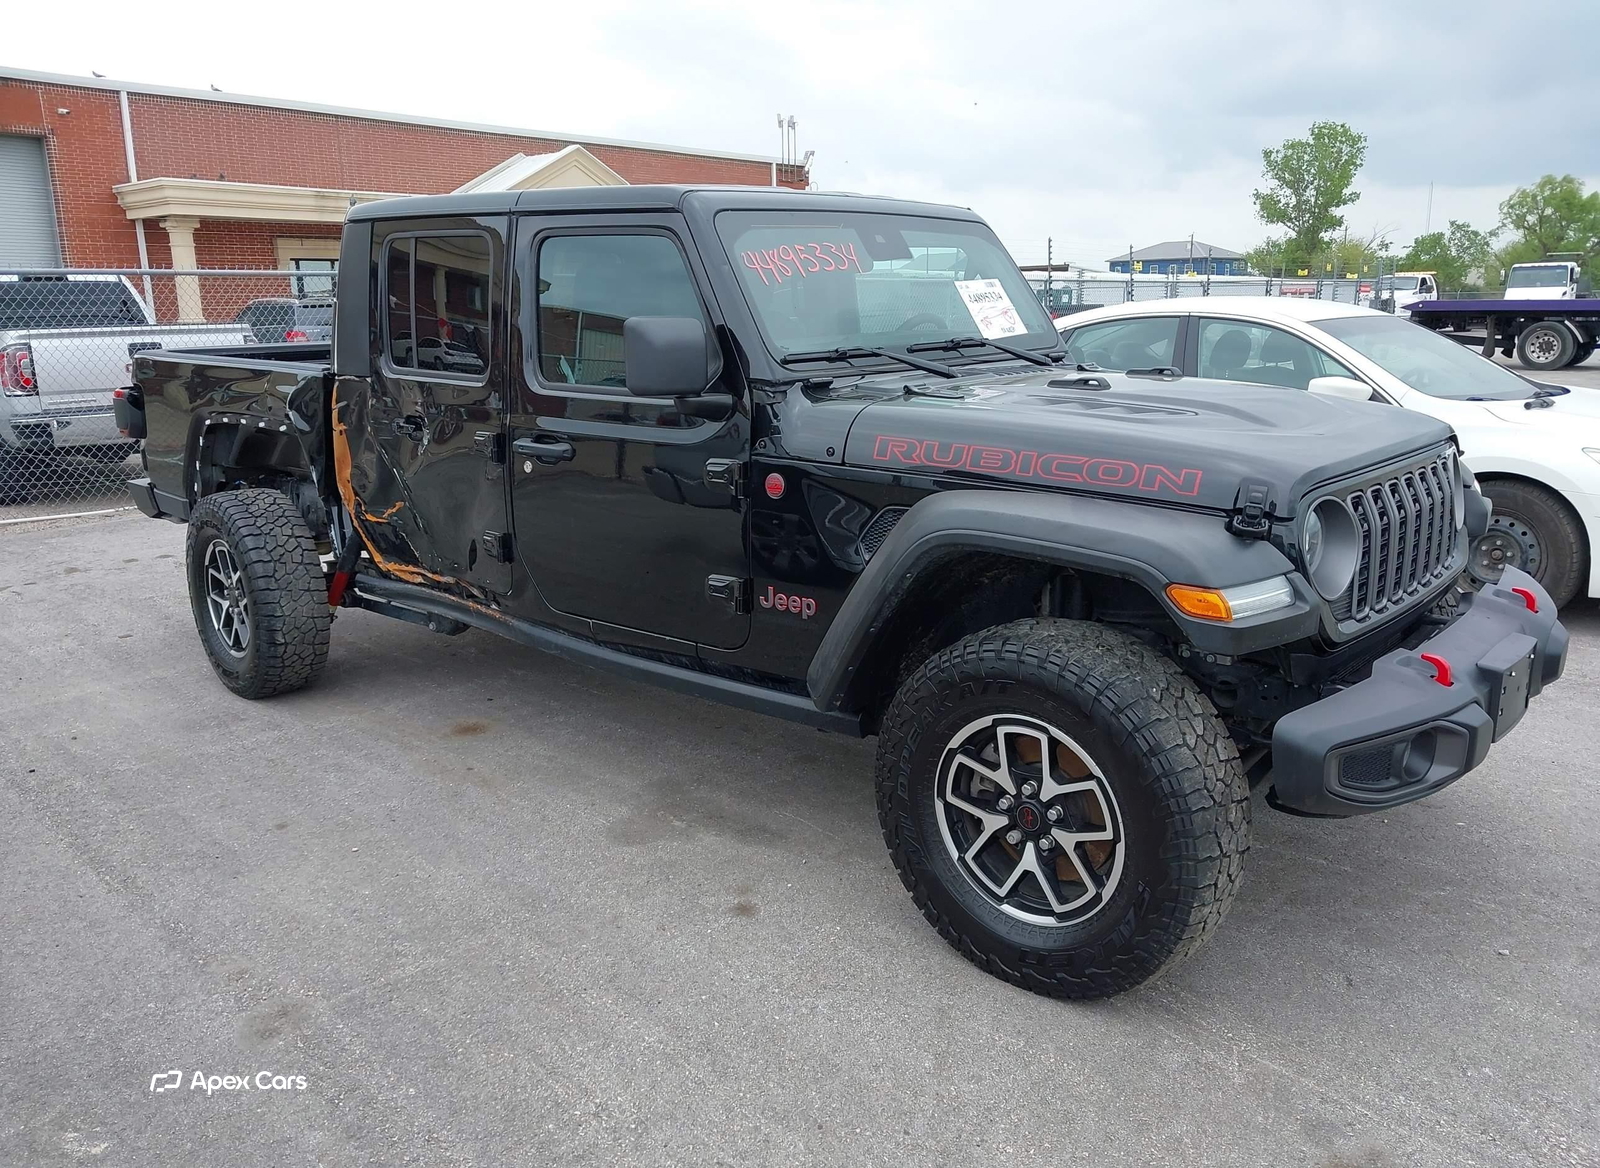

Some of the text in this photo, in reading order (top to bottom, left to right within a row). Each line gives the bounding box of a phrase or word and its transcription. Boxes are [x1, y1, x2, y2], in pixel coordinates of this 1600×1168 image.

[740, 242, 863, 286] 44895334
[873, 434, 1203, 496] RUBICON
[759, 586, 817, 620] Jeep
